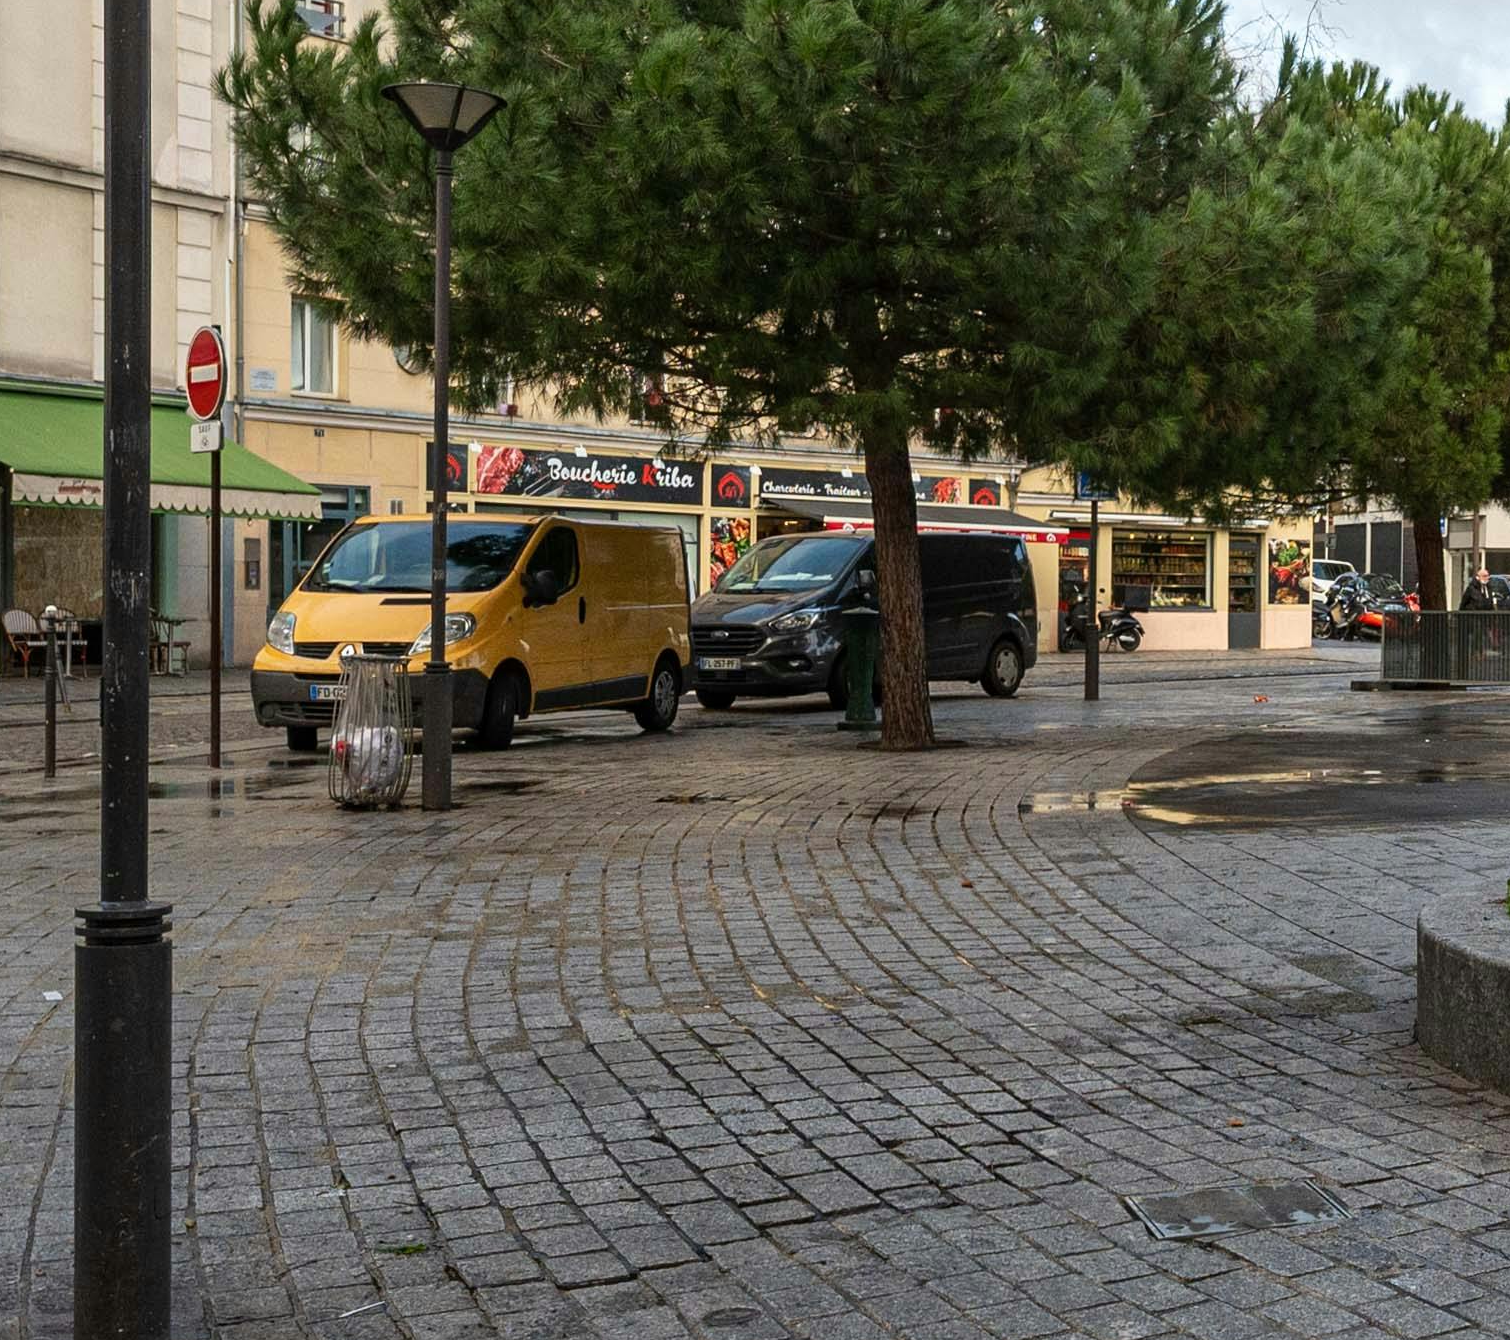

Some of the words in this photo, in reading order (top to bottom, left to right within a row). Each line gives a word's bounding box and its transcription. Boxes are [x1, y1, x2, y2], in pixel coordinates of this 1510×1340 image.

[547, 457, 638, 485] Boucherie
[642, 463, 696, 489] Kriba
[763, 481, 815, 495] Charcuterie
[824, 483, 861, 497] Traiteur
